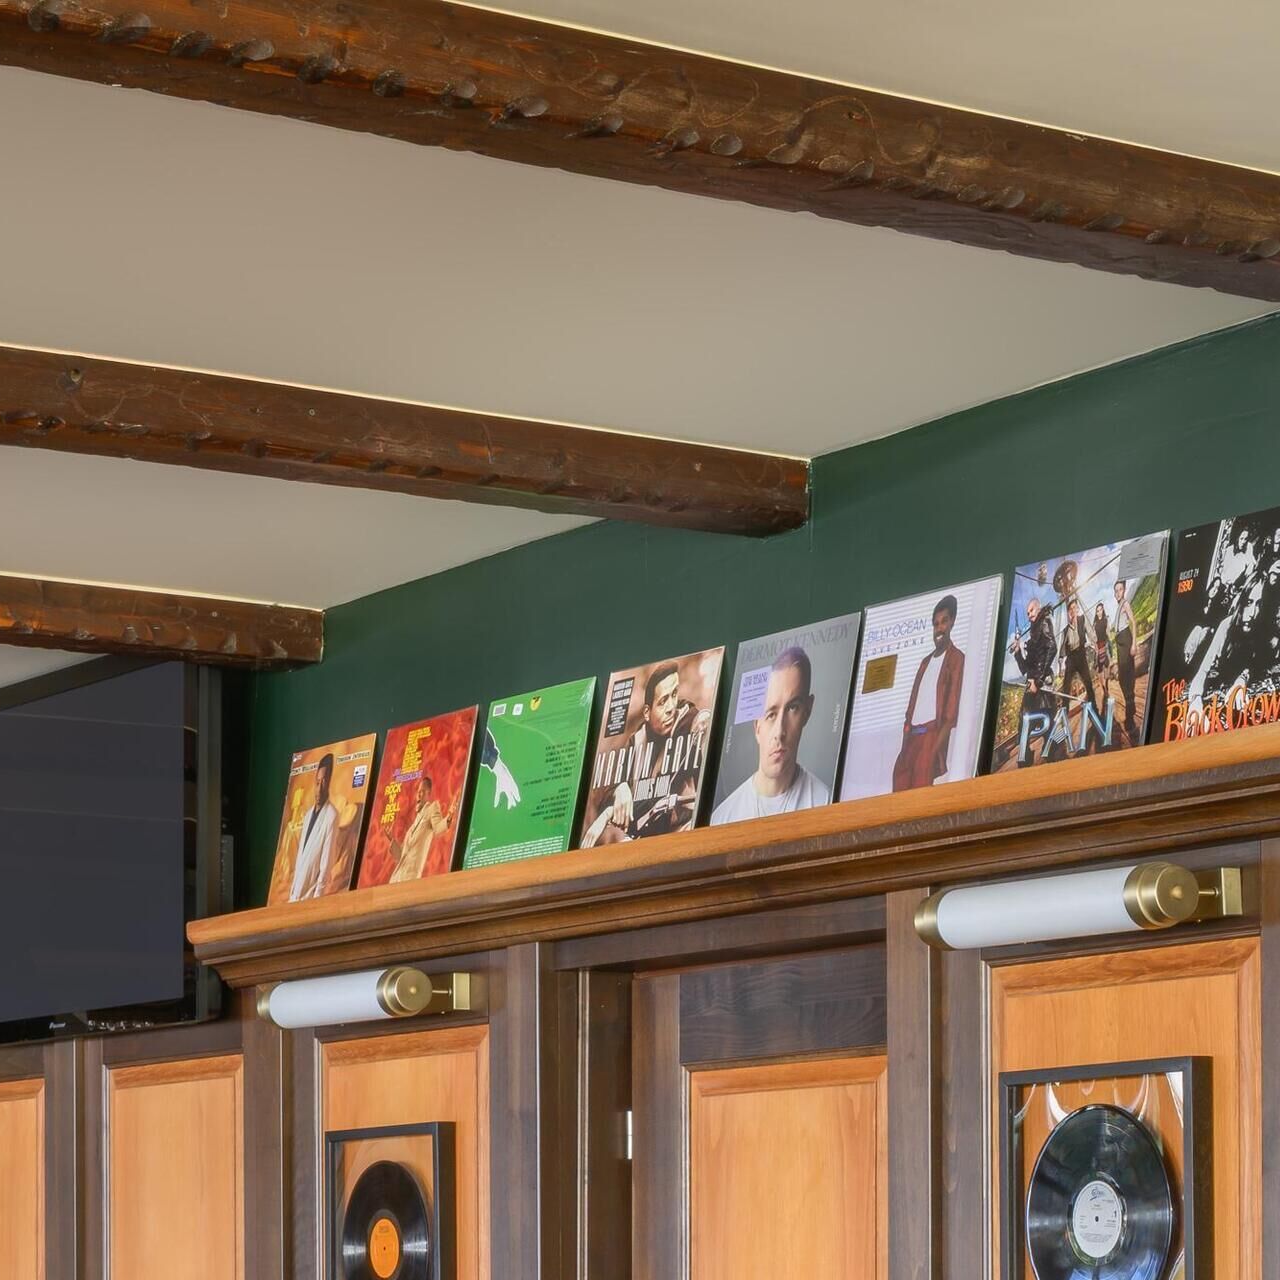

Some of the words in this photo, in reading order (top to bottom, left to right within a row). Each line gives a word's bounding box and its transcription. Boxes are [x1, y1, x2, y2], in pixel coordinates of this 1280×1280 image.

[892, 618, 927, 637] OCEAN
[741, 637, 793, 665] DERMOT
[789, 622, 853, 648] KENNEDY
[1163, 677, 1188, 705] The
[1017, 698, 1116, 762] PAN
[1164, 699, 1223, 742] Black
[593, 741, 654, 789] MARVIN
[661, 731, 705, 775] GAYE
[385, 783, 402, 797] ROCK
[381, 812, 396, 825] HITS
[385, 802, 401, 814] ROLL
